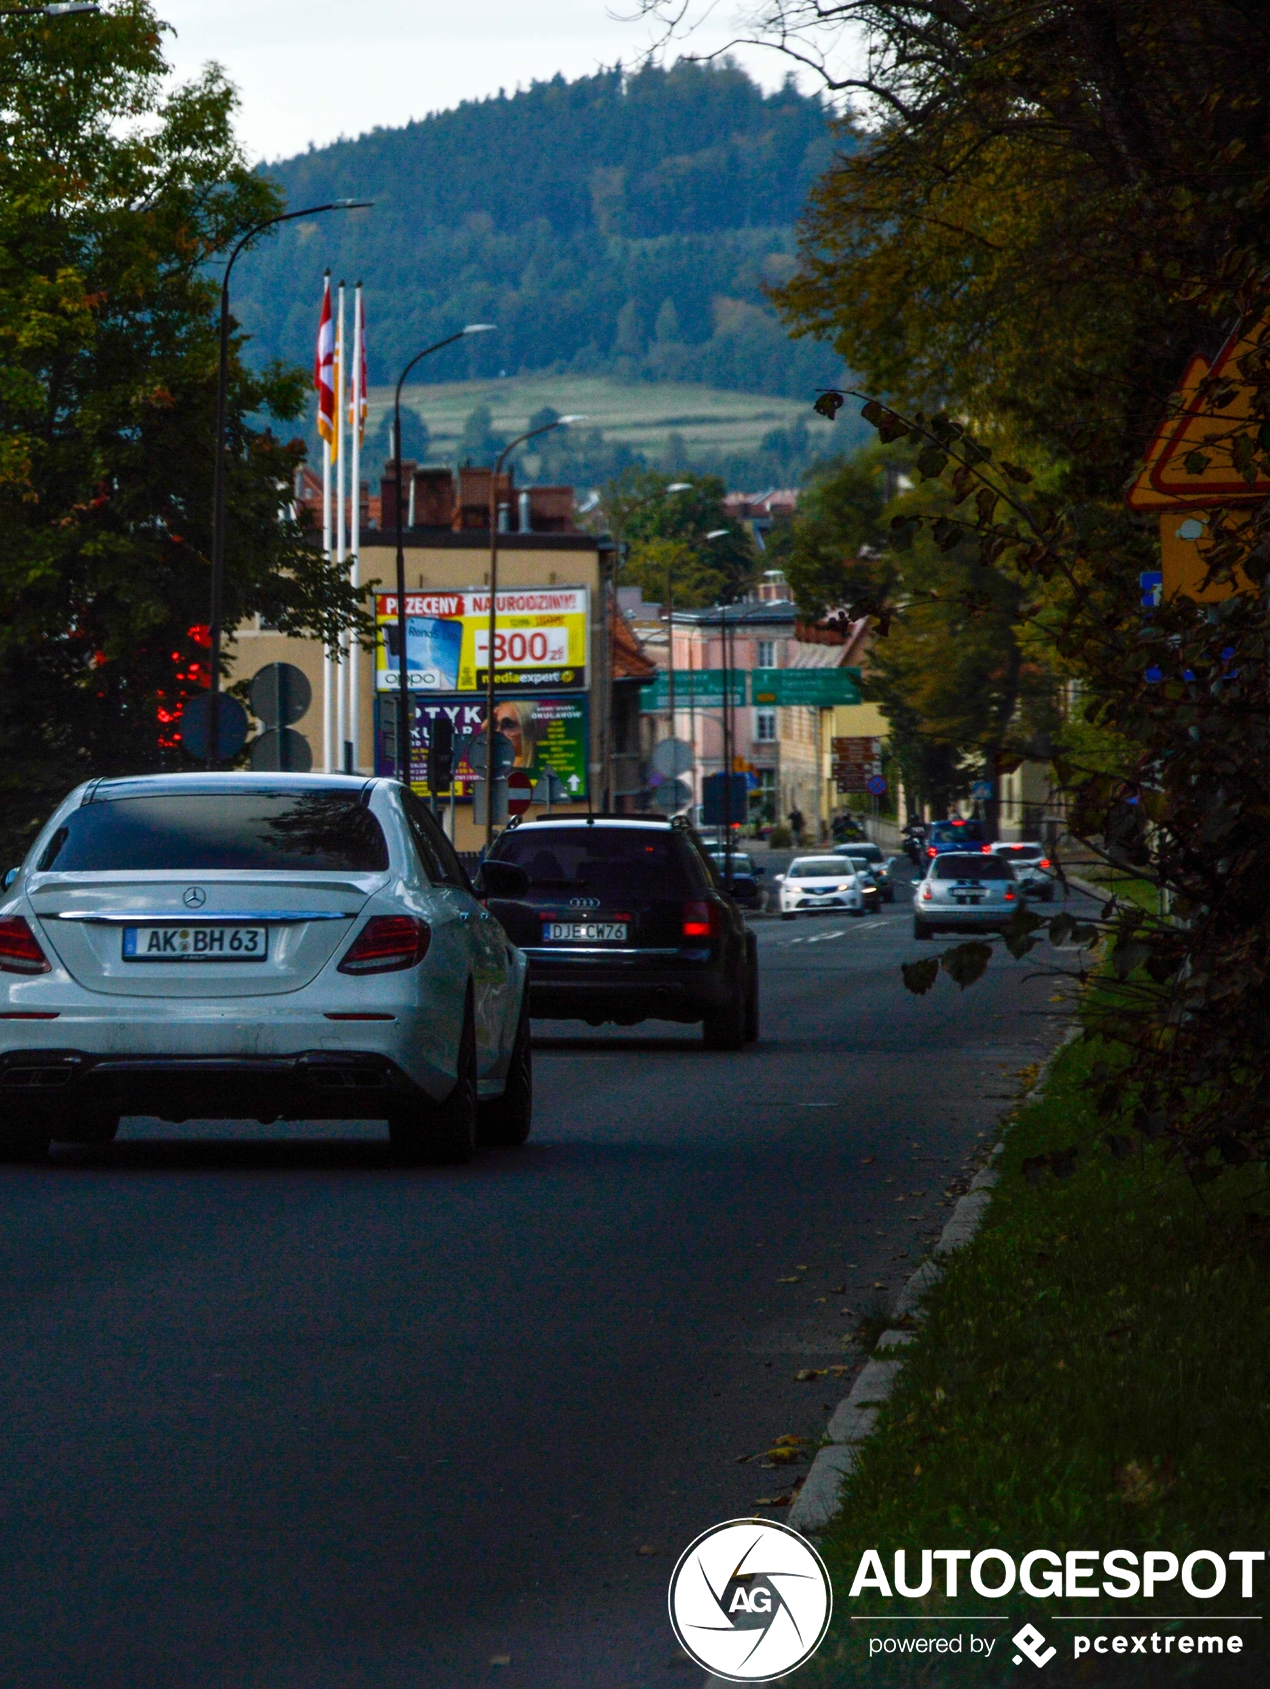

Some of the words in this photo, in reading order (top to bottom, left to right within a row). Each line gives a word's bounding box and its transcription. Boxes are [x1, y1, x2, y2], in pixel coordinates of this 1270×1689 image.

[147, 929, 178, 952] AK
[193, 929, 225, 952] BH
[229, 929, 259, 952] 63
[552, 924, 581, 939] DJE
[586, 924, 624, 939] CW76
